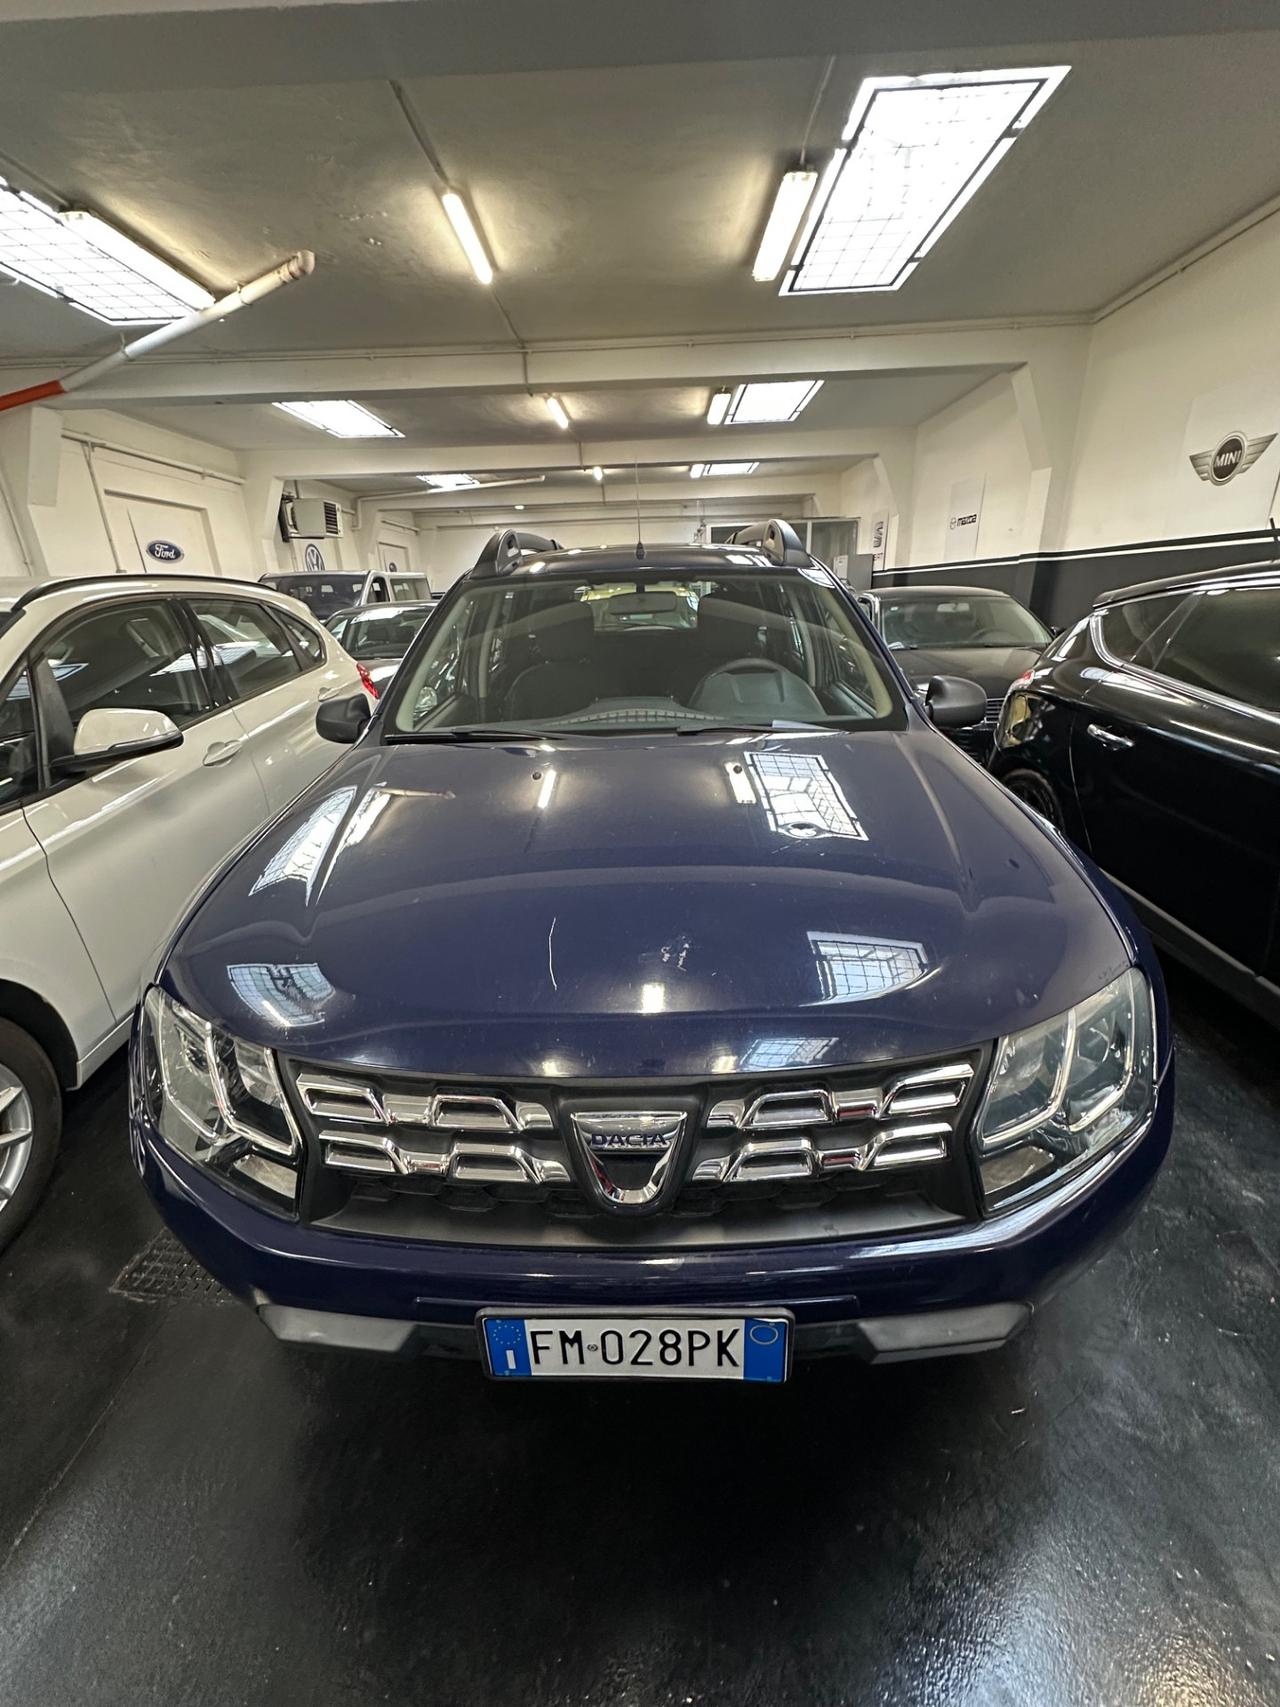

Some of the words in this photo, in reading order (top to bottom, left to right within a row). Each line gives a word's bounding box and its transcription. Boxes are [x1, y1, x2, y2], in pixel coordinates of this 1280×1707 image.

[1214, 449, 1242, 467] MINI
[154, 543, 176, 559] Ford
[591, 1133, 667, 1146] DACIA
